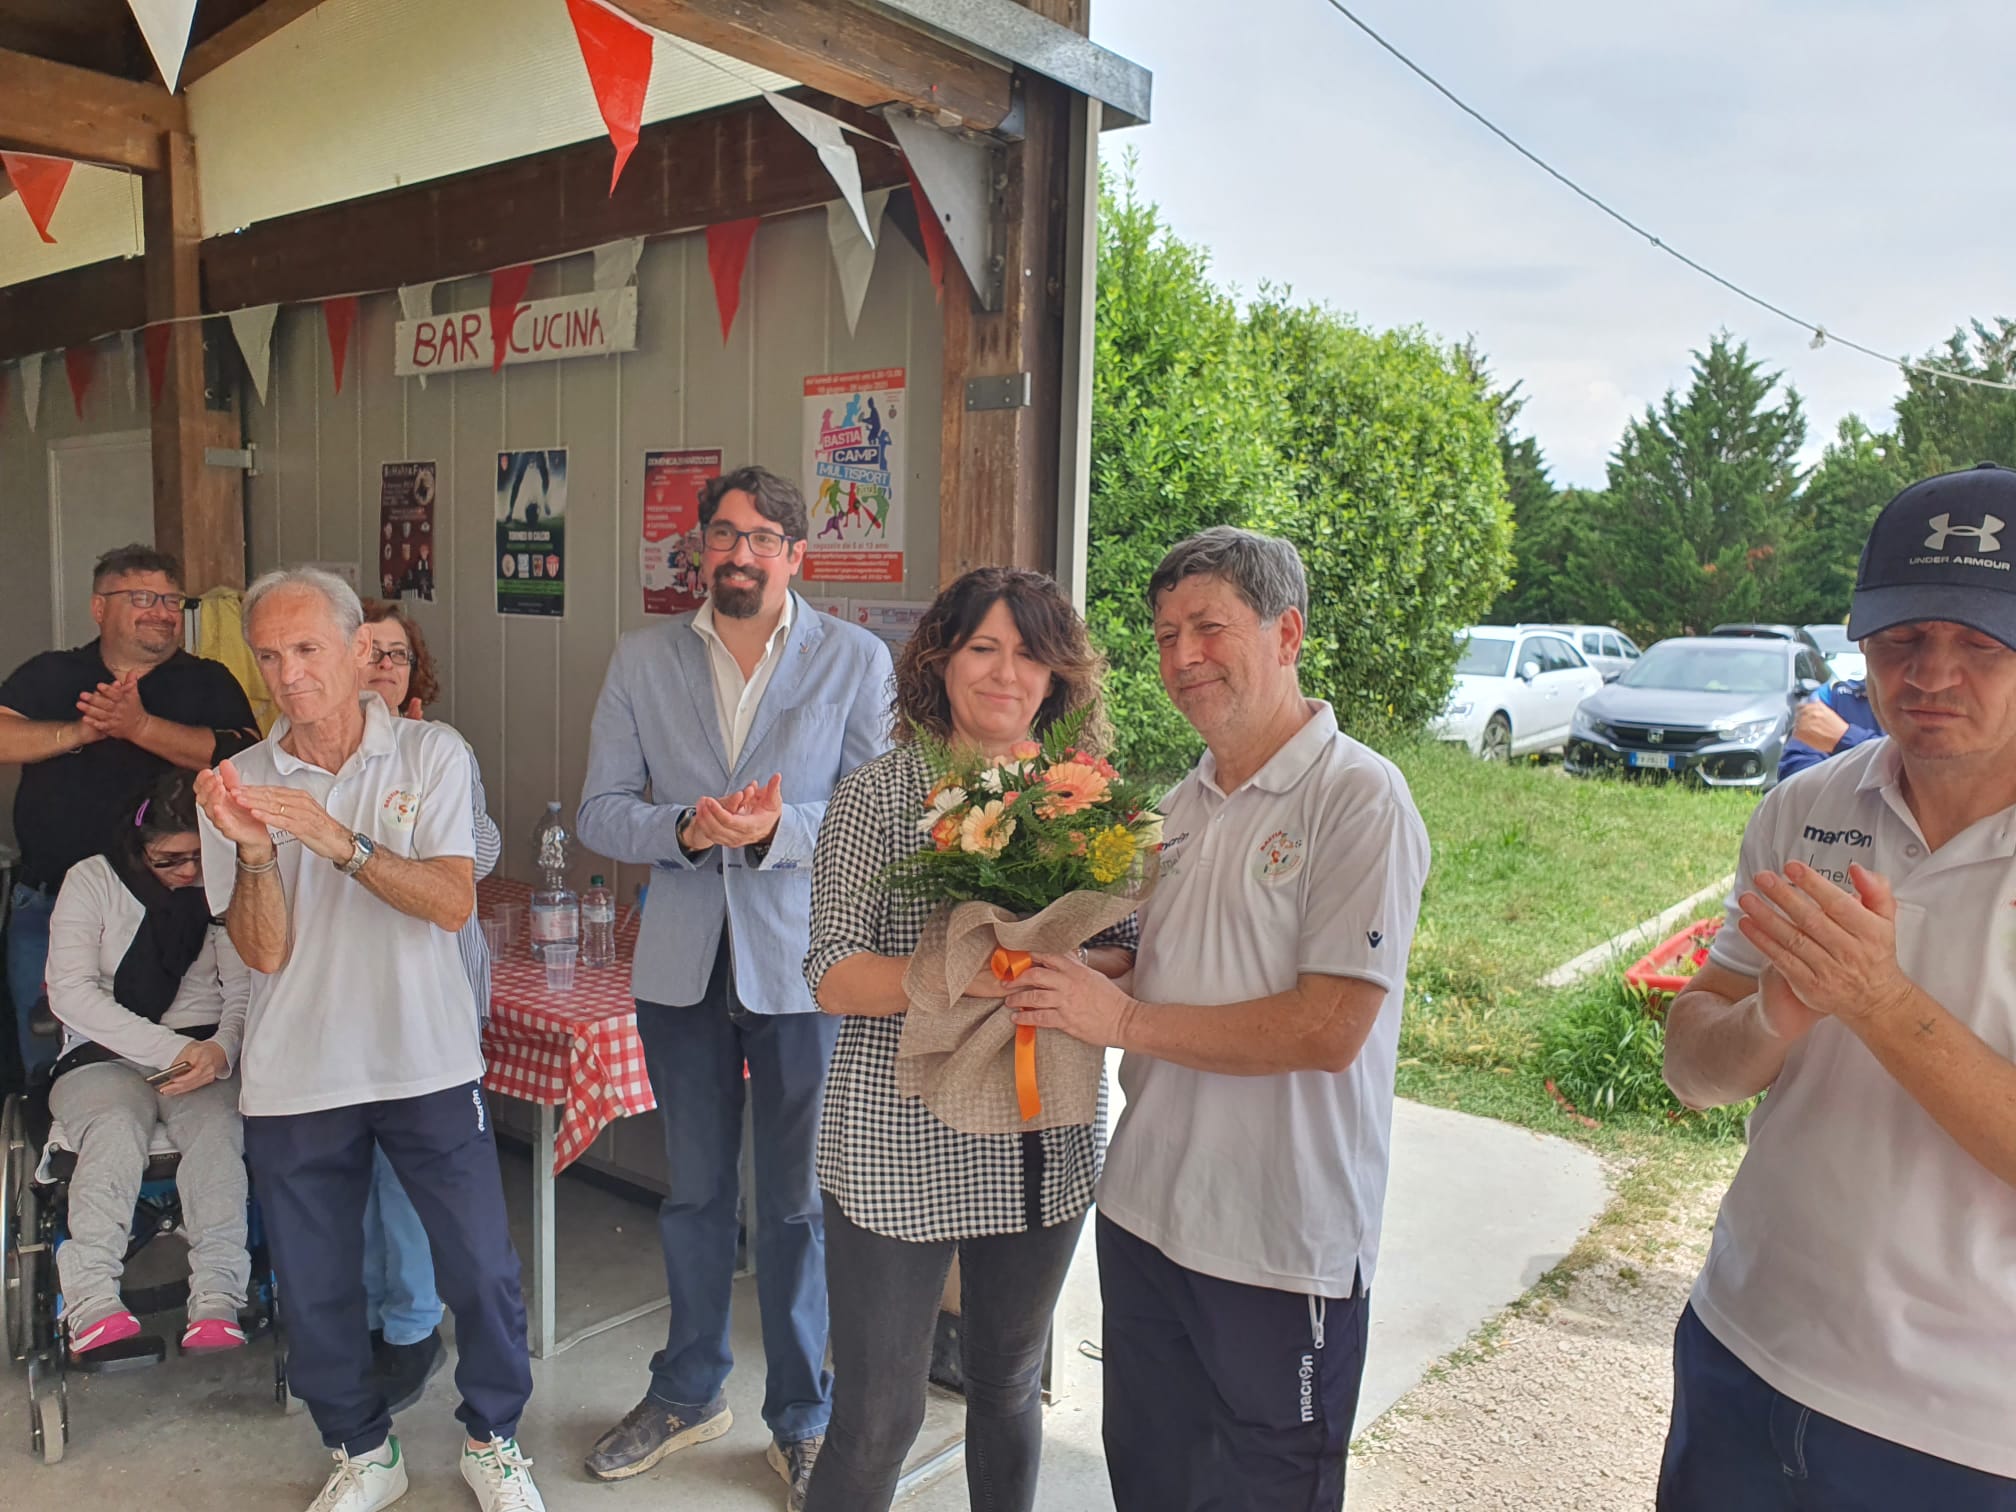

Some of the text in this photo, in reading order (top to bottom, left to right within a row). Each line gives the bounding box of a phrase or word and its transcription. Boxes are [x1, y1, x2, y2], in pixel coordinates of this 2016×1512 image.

[412, 304, 605, 367] BAR CUCINA
[824, 429, 861, 448] BASTIA
[834, 448, 878, 462] CAMP
[819, 463, 888, 485] MULTISPORT
[1909, 555, 2011, 571] UNDER ARMOUR
[1803, 825, 1873, 848] maron
[1298, 1354, 1314, 1423] macron
